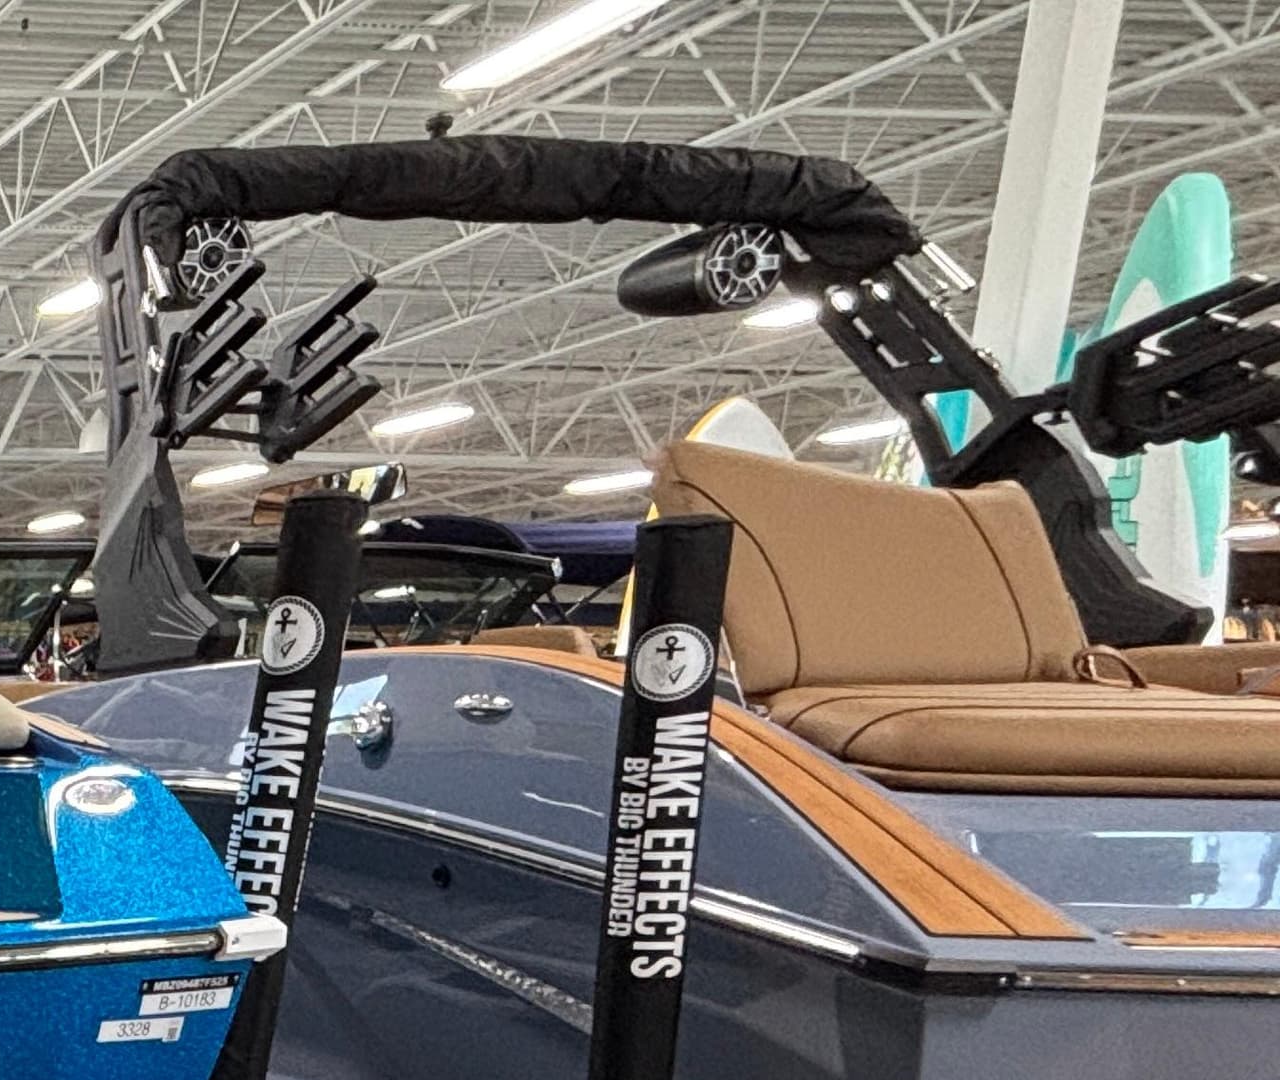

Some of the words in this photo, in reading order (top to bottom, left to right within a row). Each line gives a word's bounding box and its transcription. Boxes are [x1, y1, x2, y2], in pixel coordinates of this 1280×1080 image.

[250, 689, 316, 799] WAKE
[622, 756, 650, 788] BY
[646, 711, 709, 819] WAKE
[236, 806, 294, 916] EFFEC
[617, 792, 647, 830] BIG
[607, 834, 642, 938] THUNDER
[630, 829, 696, 979] EFFECTS
[116, 1022, 151, 1038] 3328
[158, 991, 217, 1011] B-10183
